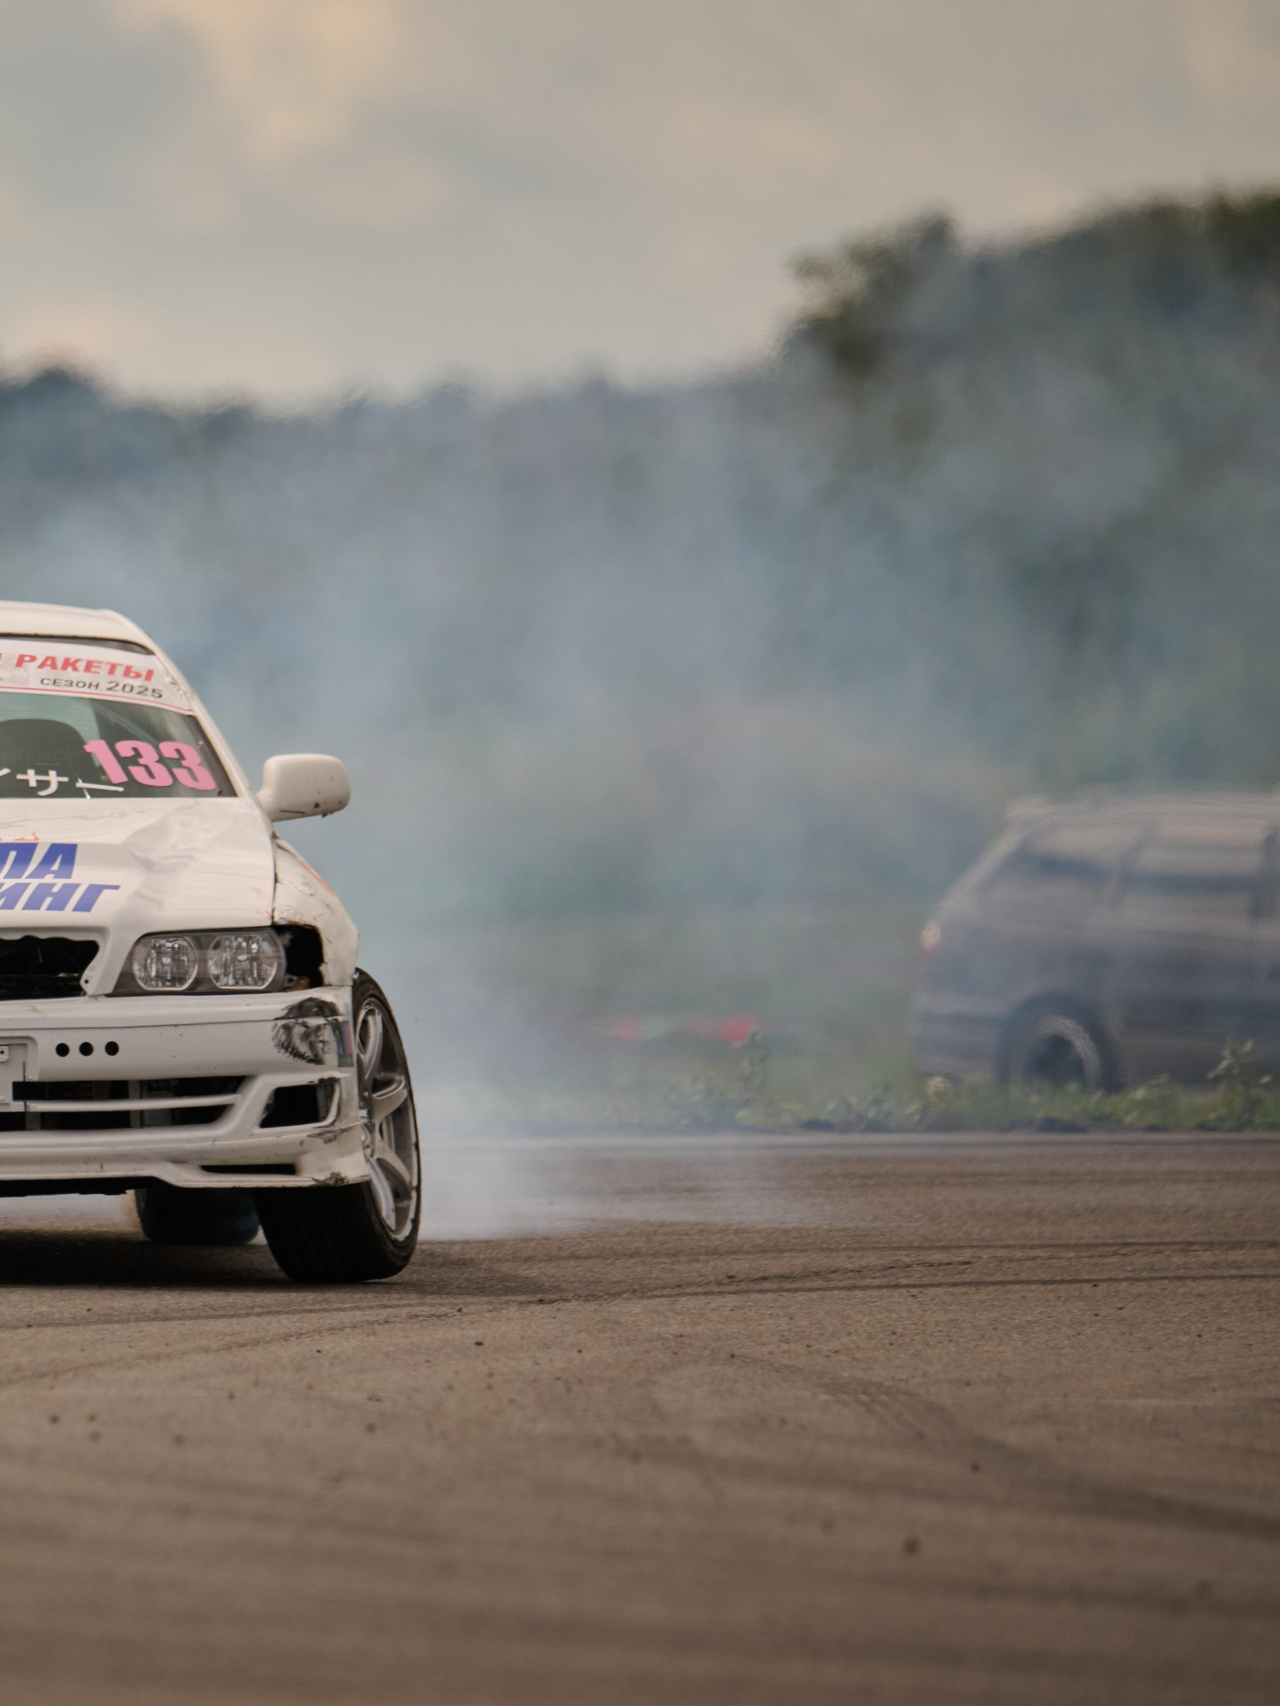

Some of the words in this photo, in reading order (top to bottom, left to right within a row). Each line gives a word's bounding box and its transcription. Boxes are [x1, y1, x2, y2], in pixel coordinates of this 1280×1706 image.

[15, 654, 155, 682] РАКЕТЫ
[40, 677, 100, 690] СЕЗОН
[106, 681, 164, 699] 2025
[83, 739, 217, 791] 133
